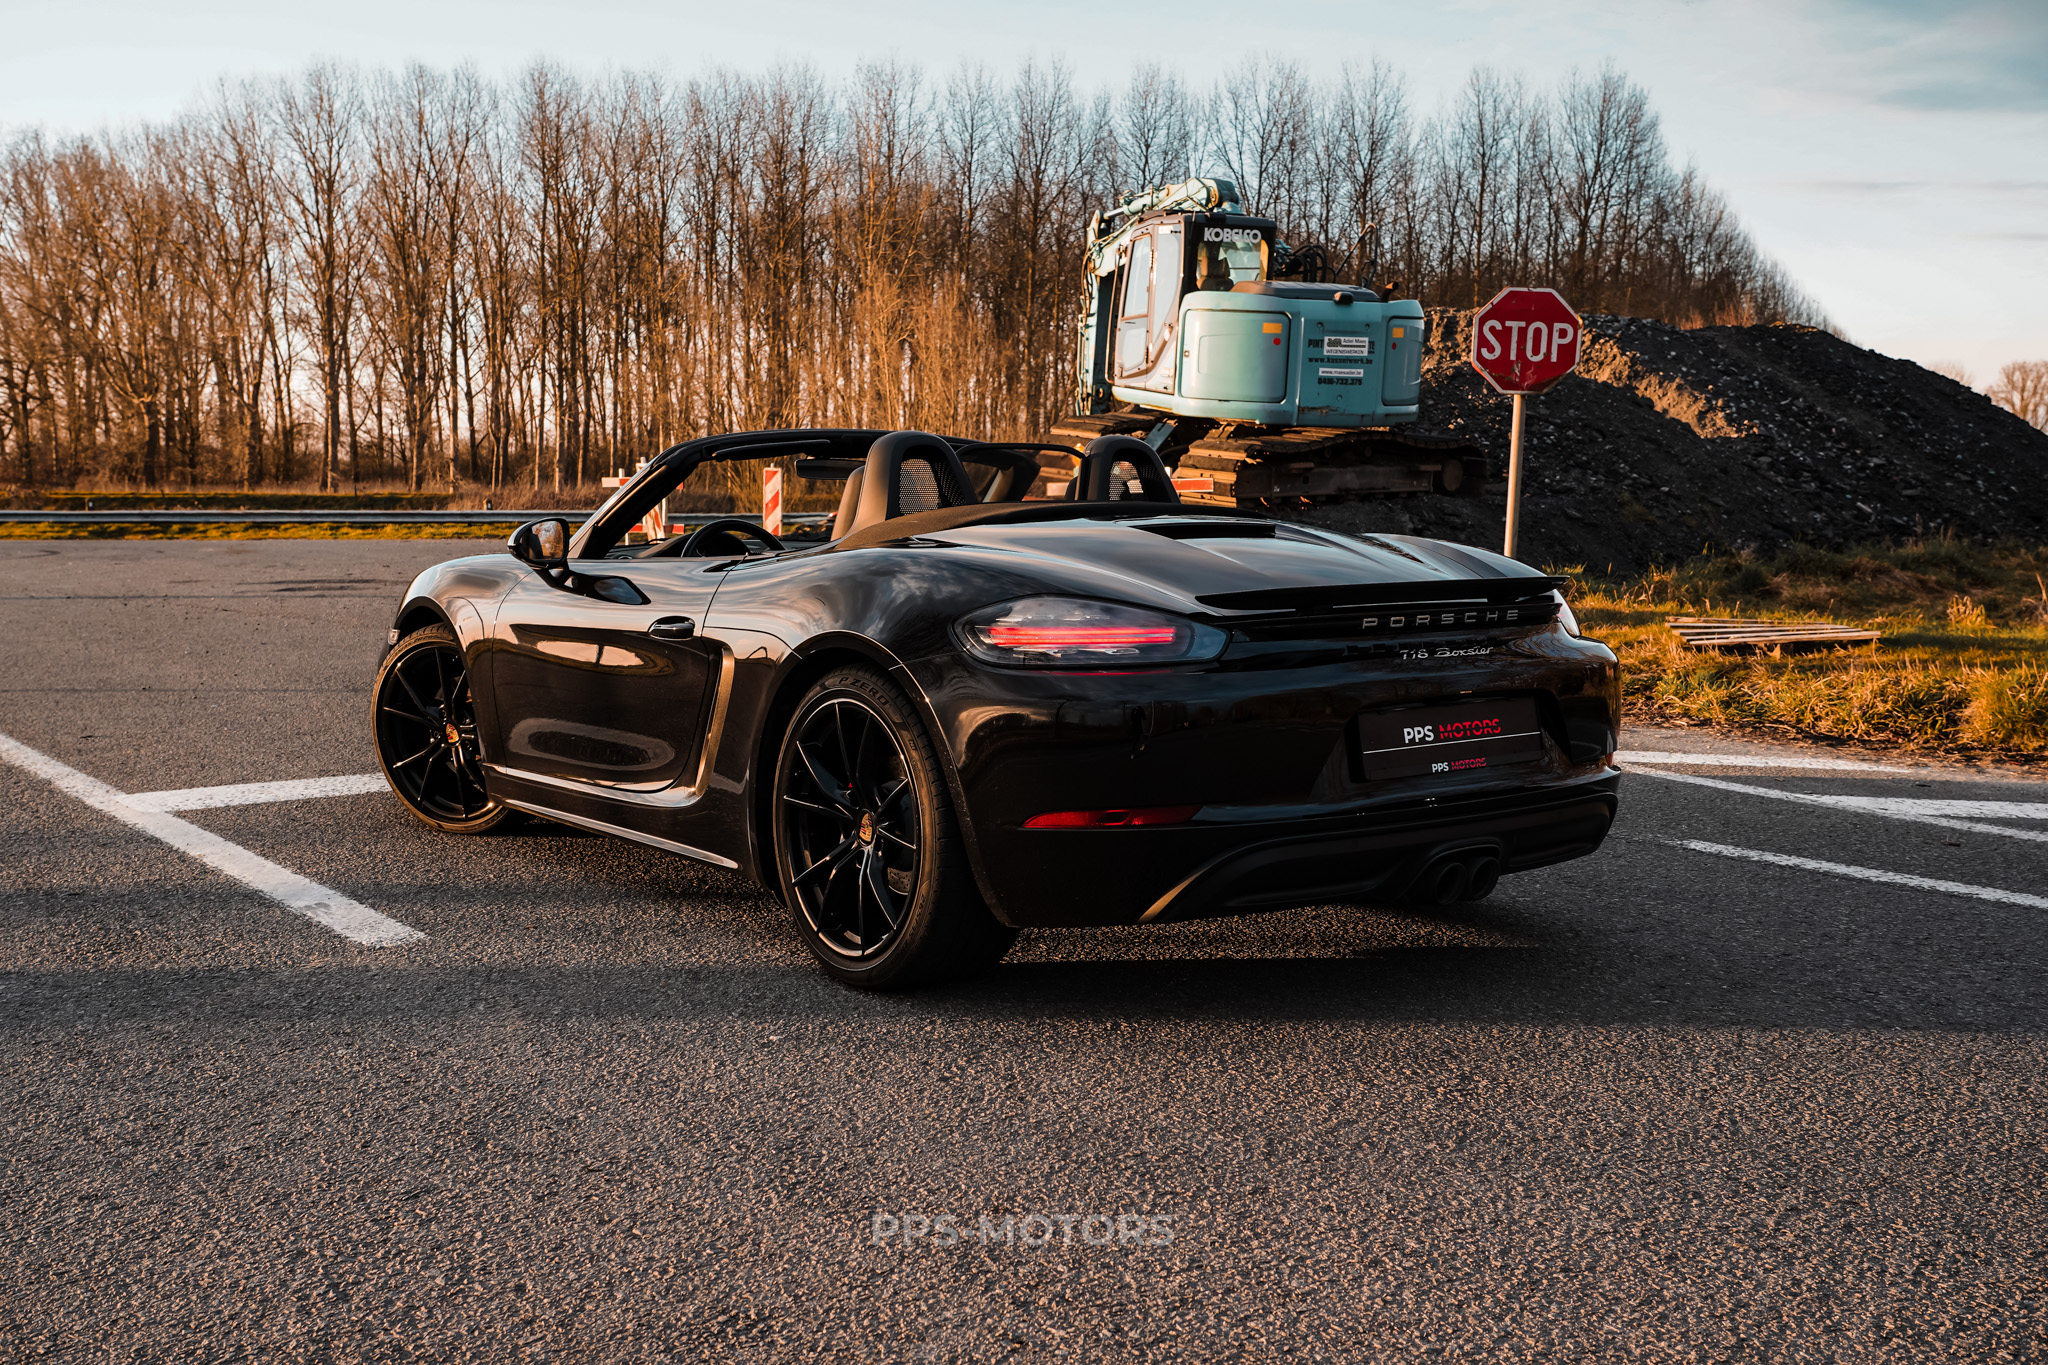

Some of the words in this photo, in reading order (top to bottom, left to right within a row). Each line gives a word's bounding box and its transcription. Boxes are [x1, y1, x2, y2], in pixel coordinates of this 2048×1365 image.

[1204, 227, 1262, 244] KOBELCO
[1480, 319, 1574, 362] STOP
[1362, 609, 1519, 629] PORSCHE
[1434, 646, 1494, 658] Boxster
[850, 678, 891, 706] ZERO
[1403, 725, 1435, 743] PPS
[1438, 718, 1502, 740] MOTORS
[1431, 762, 1449, 773] PPS
[1451, 757, 1487, 771] MOTORS
